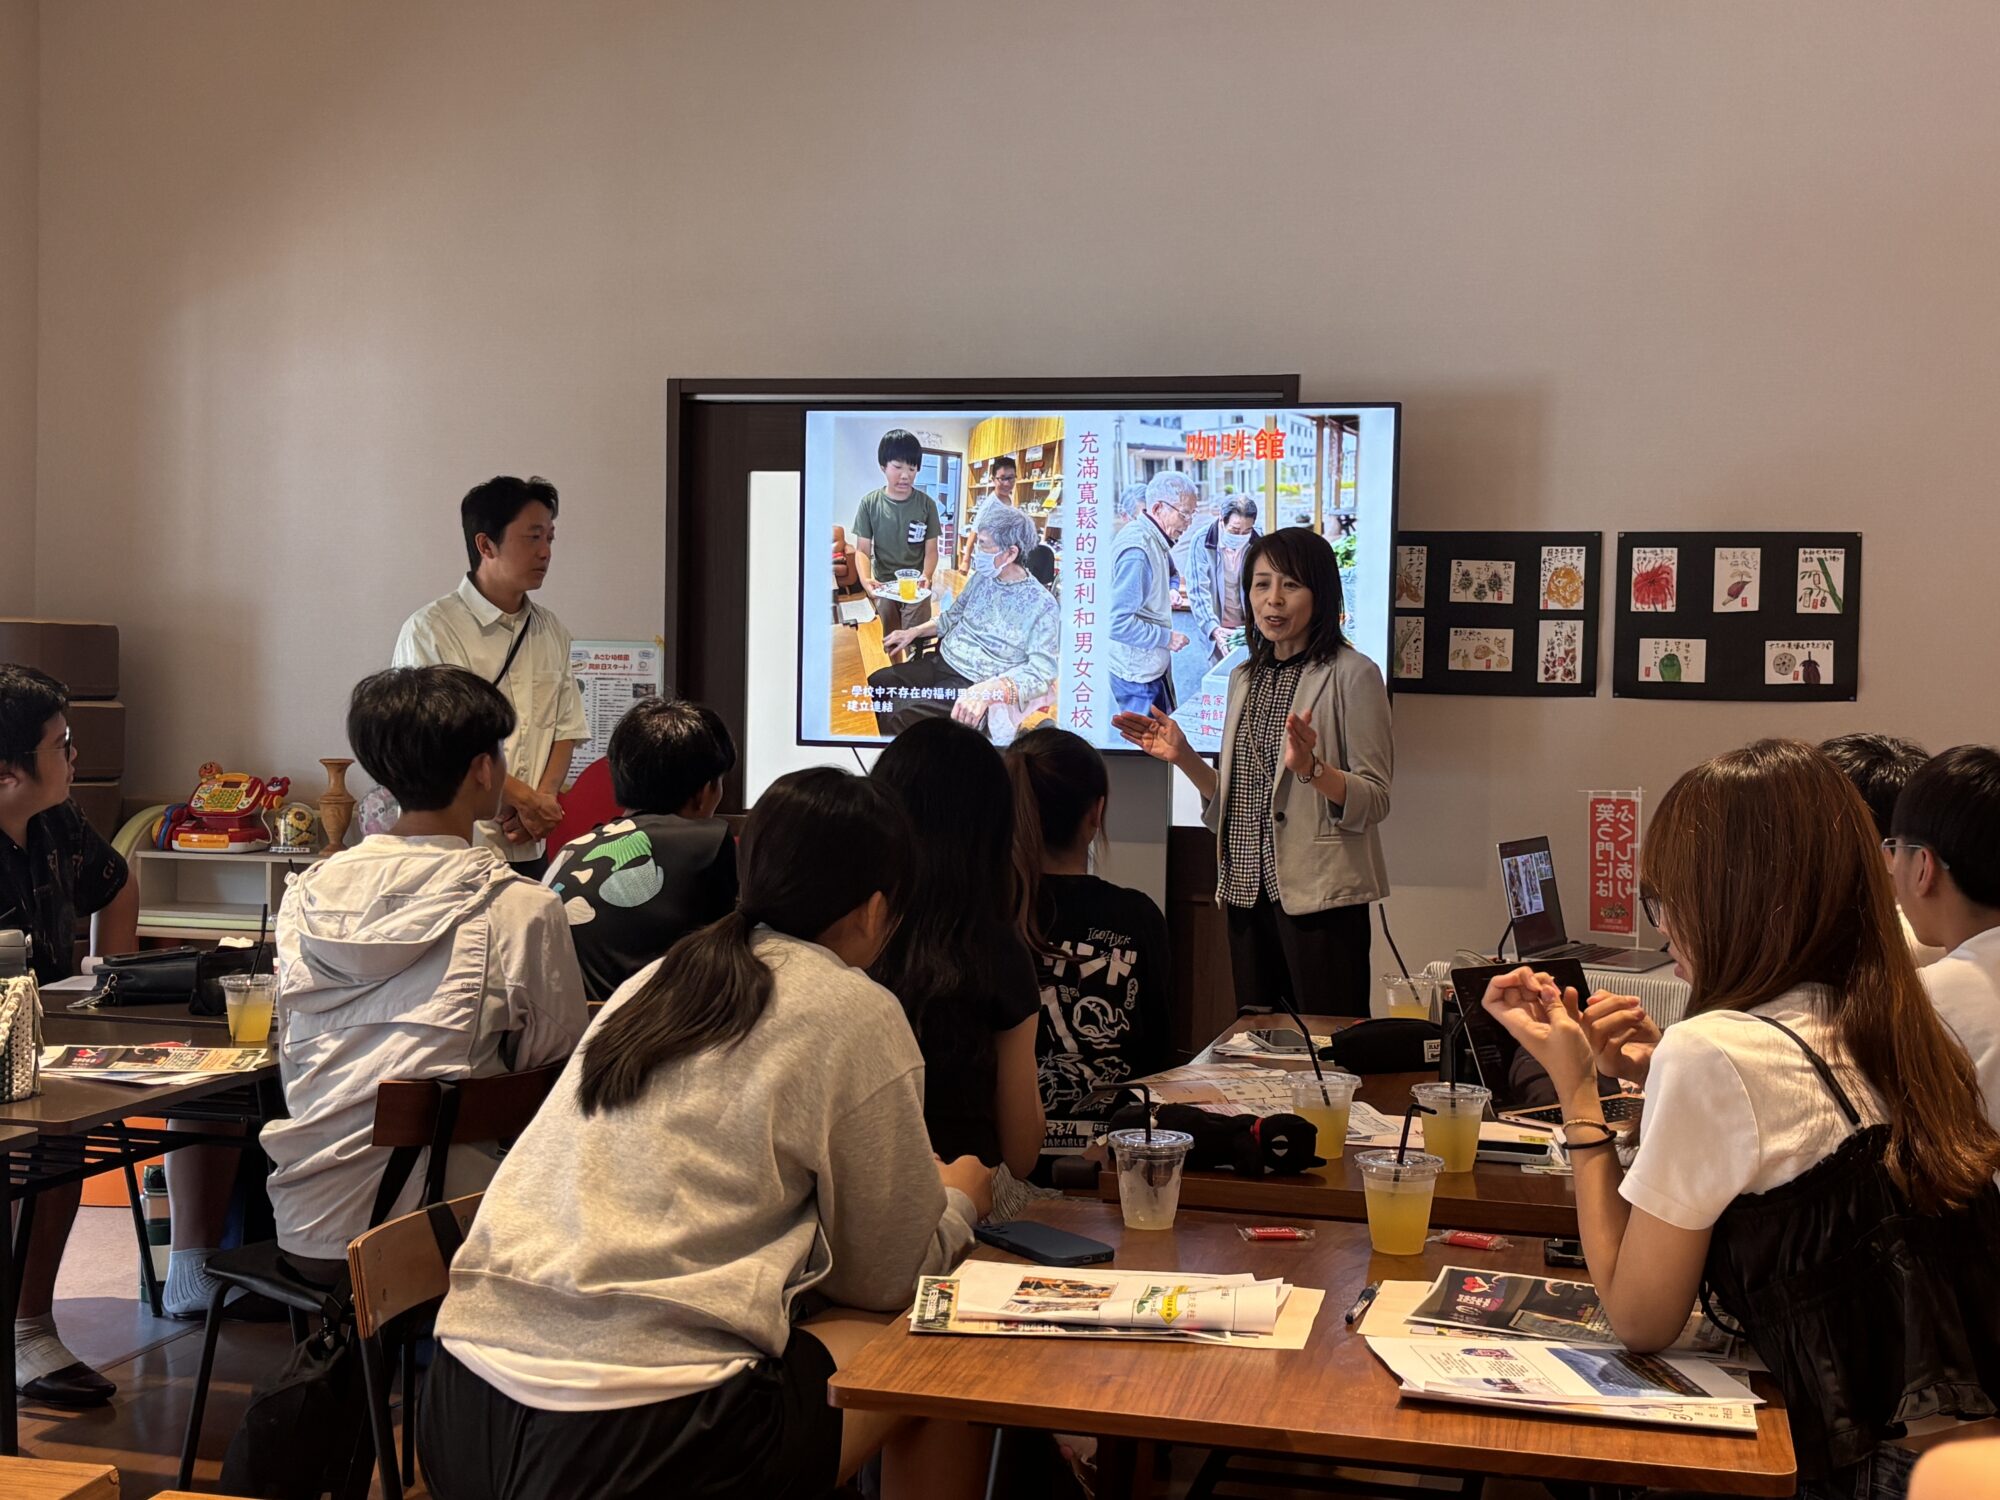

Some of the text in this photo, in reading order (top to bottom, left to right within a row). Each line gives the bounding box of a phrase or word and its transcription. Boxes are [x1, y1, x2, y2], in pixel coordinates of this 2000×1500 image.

[1185, 428, 1286, 461] 咖啡館
[1070, 431, 1099, 729] 充滿寬鬆的福利和男女合校
